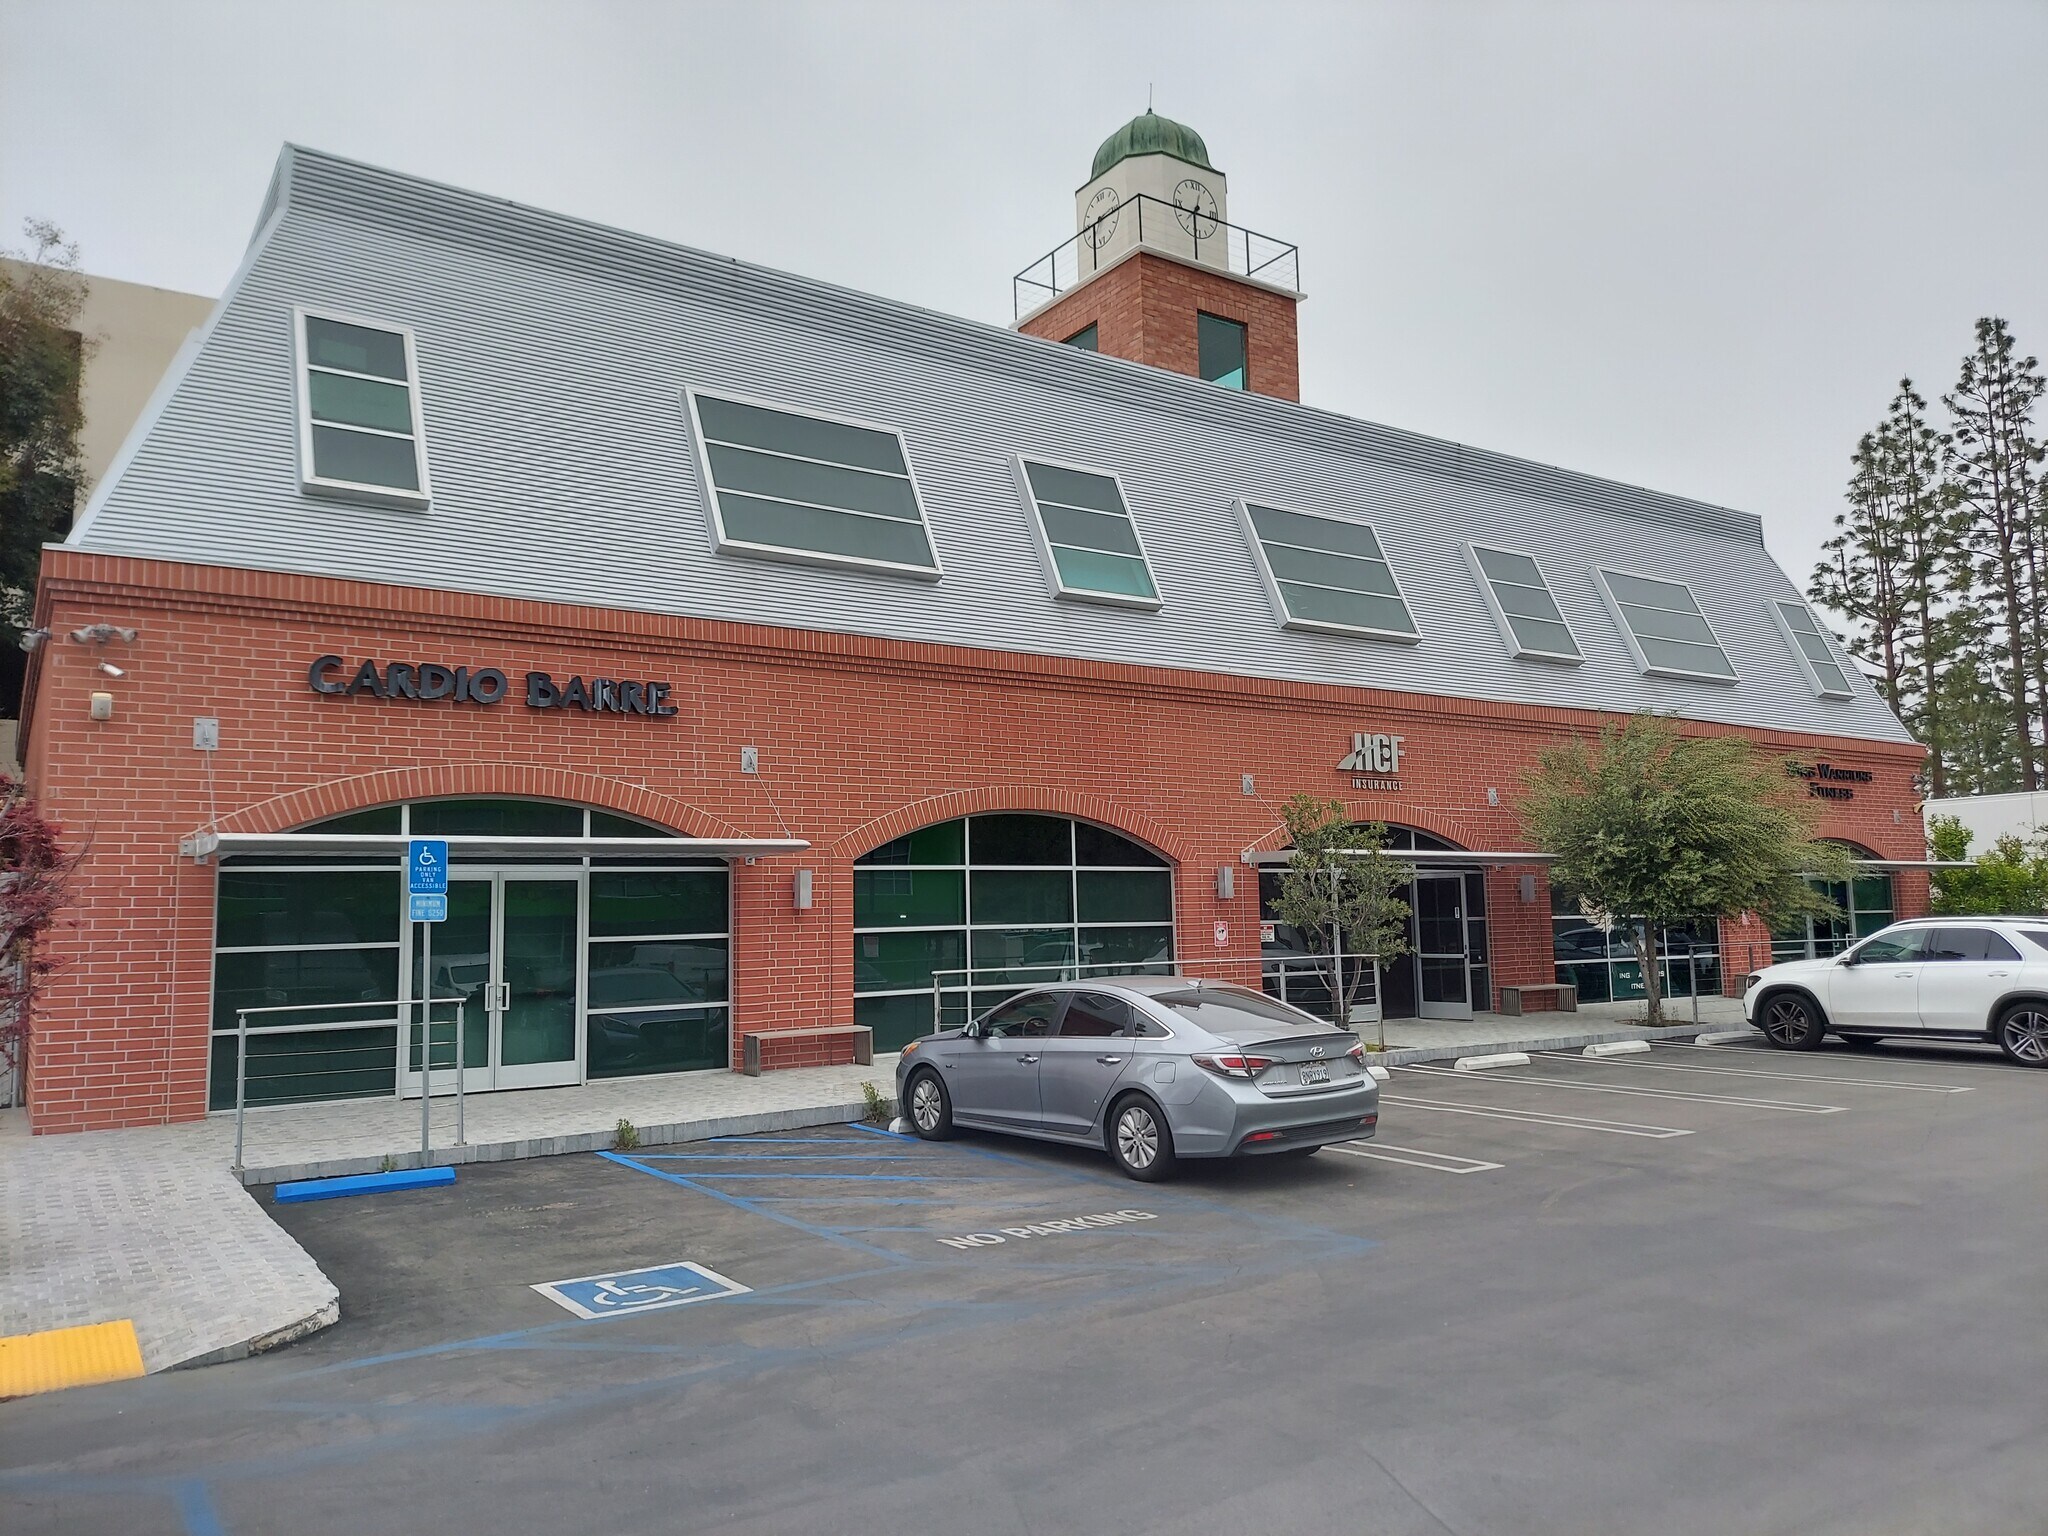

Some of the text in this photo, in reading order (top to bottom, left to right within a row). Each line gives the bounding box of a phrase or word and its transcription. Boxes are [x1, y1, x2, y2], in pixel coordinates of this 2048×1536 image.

[308, 654, 679, 717] CARDIO BARRE
[1336, 732, 1406, 773] HCF
[1352, 778, 1404, 791] INSURANCE
[411, 909, 425, 917] FINE
[936, 1209, 1158, 1250] NO PARKING
